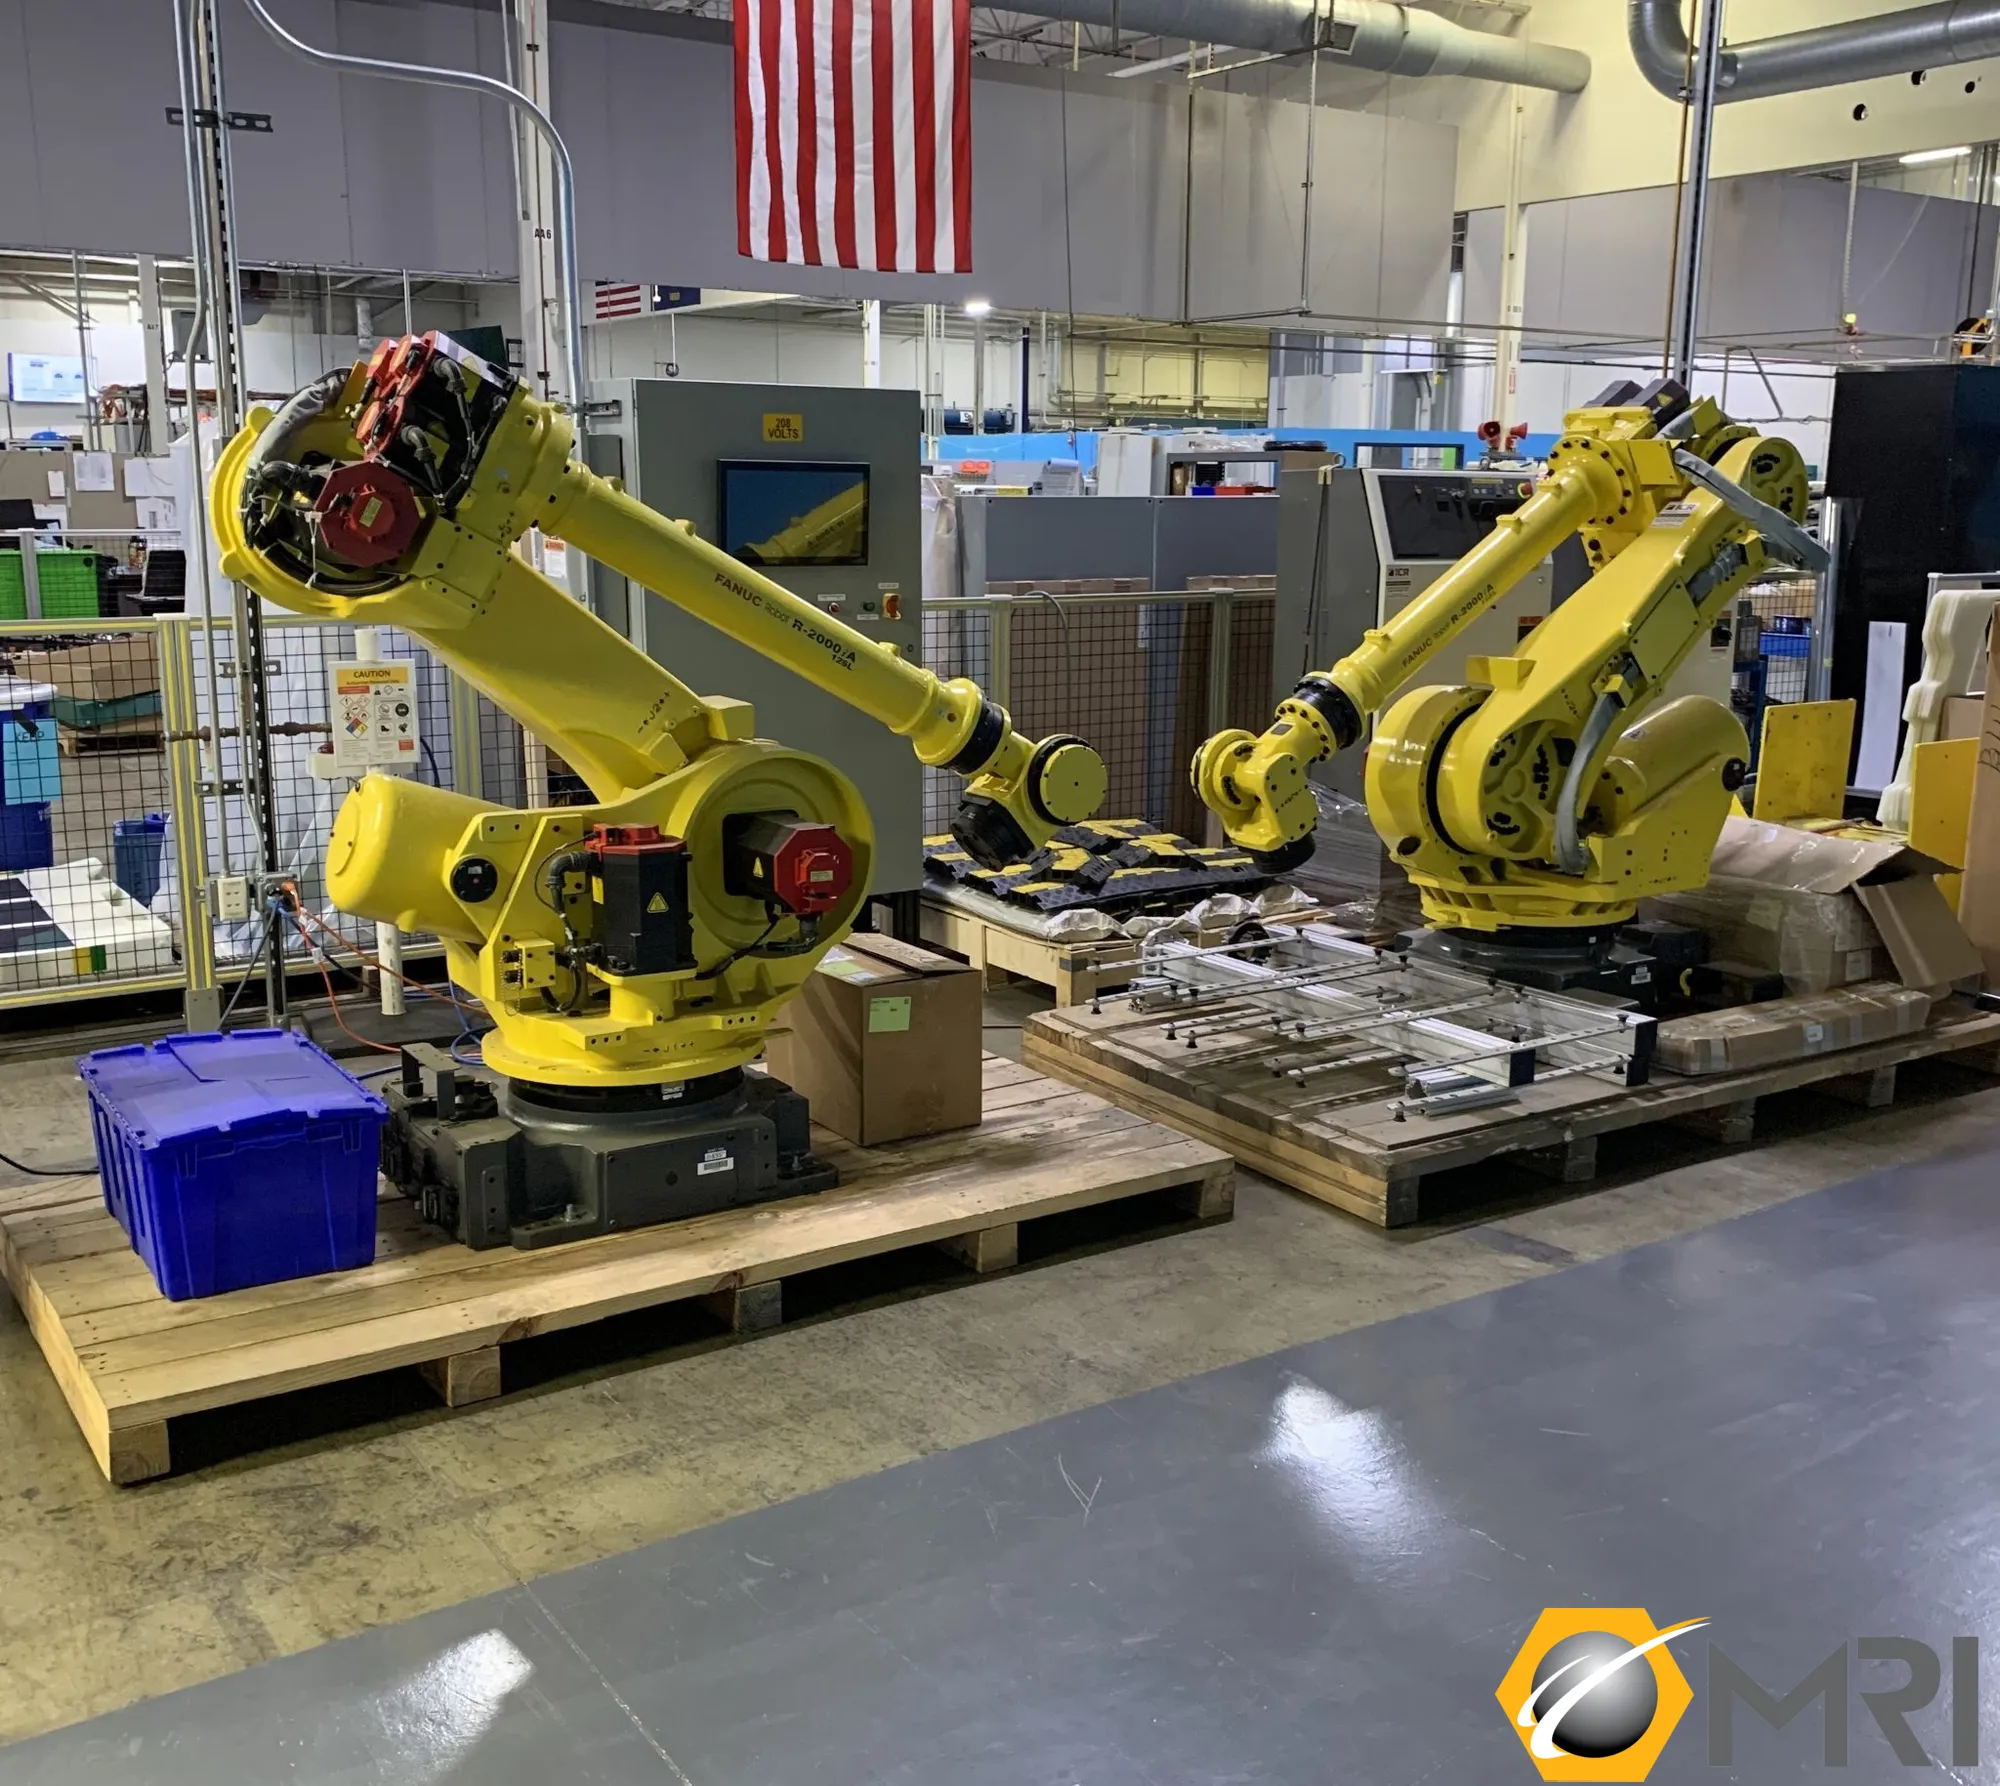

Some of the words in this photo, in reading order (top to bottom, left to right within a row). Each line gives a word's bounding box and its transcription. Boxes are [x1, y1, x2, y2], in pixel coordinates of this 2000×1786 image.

[775, 417, 792, 428] 208
[768, 428, 799, 439] VOLTS
[714, 573, 763, 607] FANUC
[764, 603, 790, 623] Robot
[1402, 637, 1433, 668] FANUC
[831, 654, 853, 671] 125L
[353, 670, 391, 679] CAUTION
[16, 730, 45, 742] KEP
